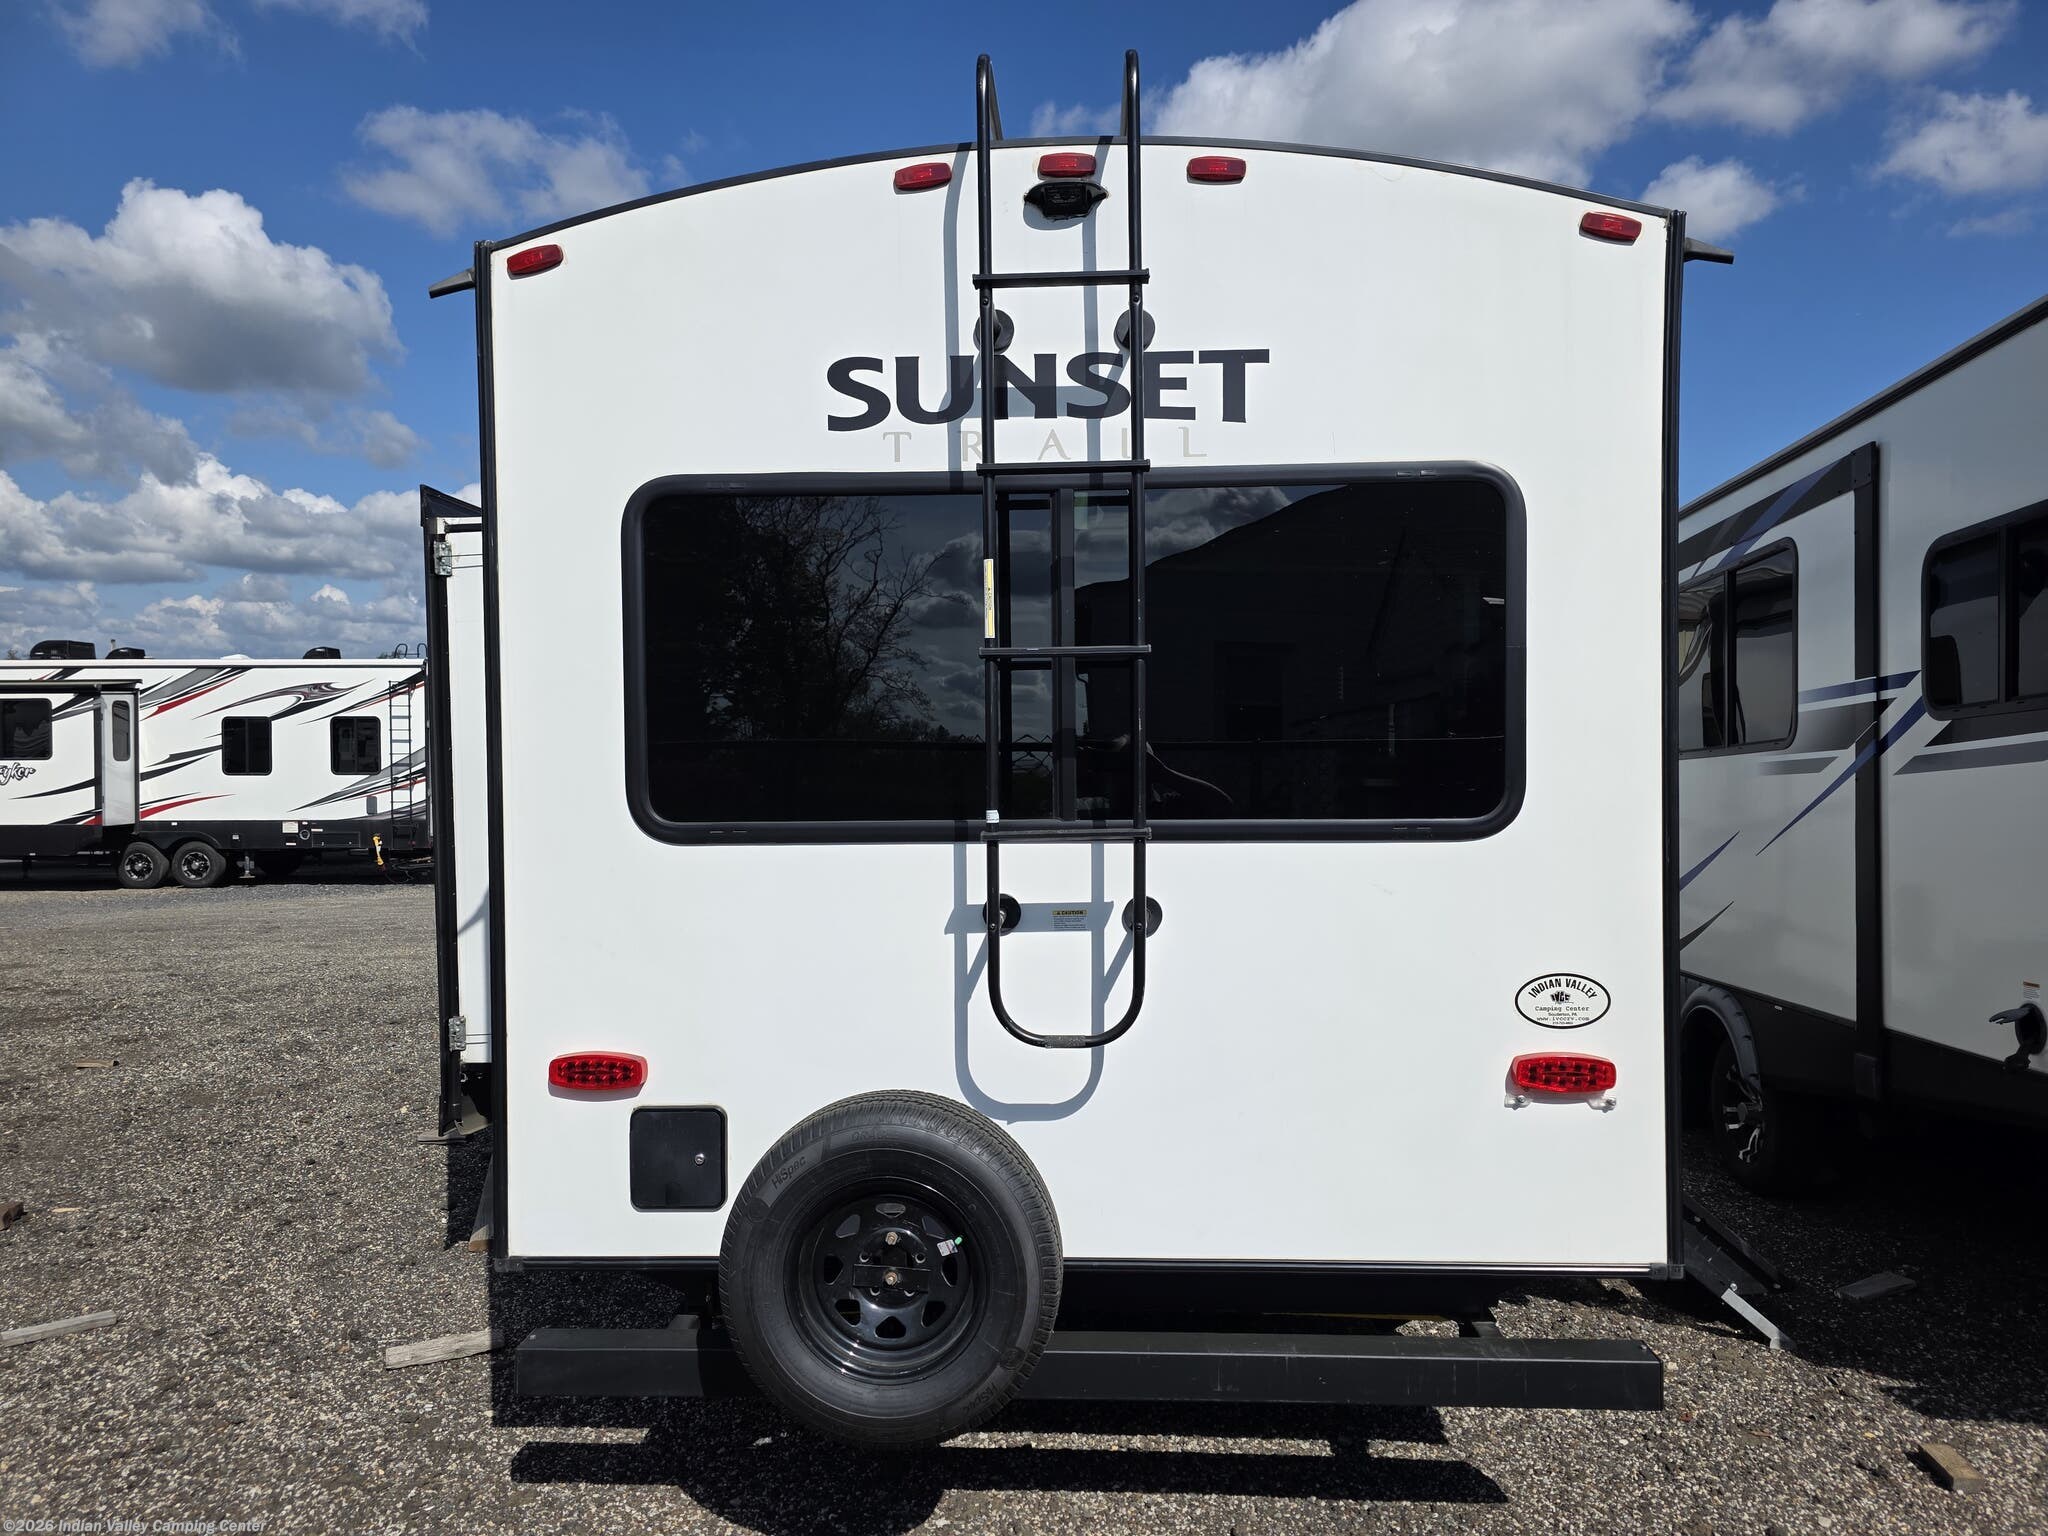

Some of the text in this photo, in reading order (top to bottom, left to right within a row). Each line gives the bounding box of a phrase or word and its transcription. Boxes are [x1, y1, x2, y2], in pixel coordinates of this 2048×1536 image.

[826, 348, 1270, 432] SUNSET
[882, 426, 1208, 463] TRAIL
[1528, 978, 1598, 999] INDIAN VALLEY
[1534, 1005, 1562, 1013] Camping
[771, 1156, 806, 1190] HiSpec
